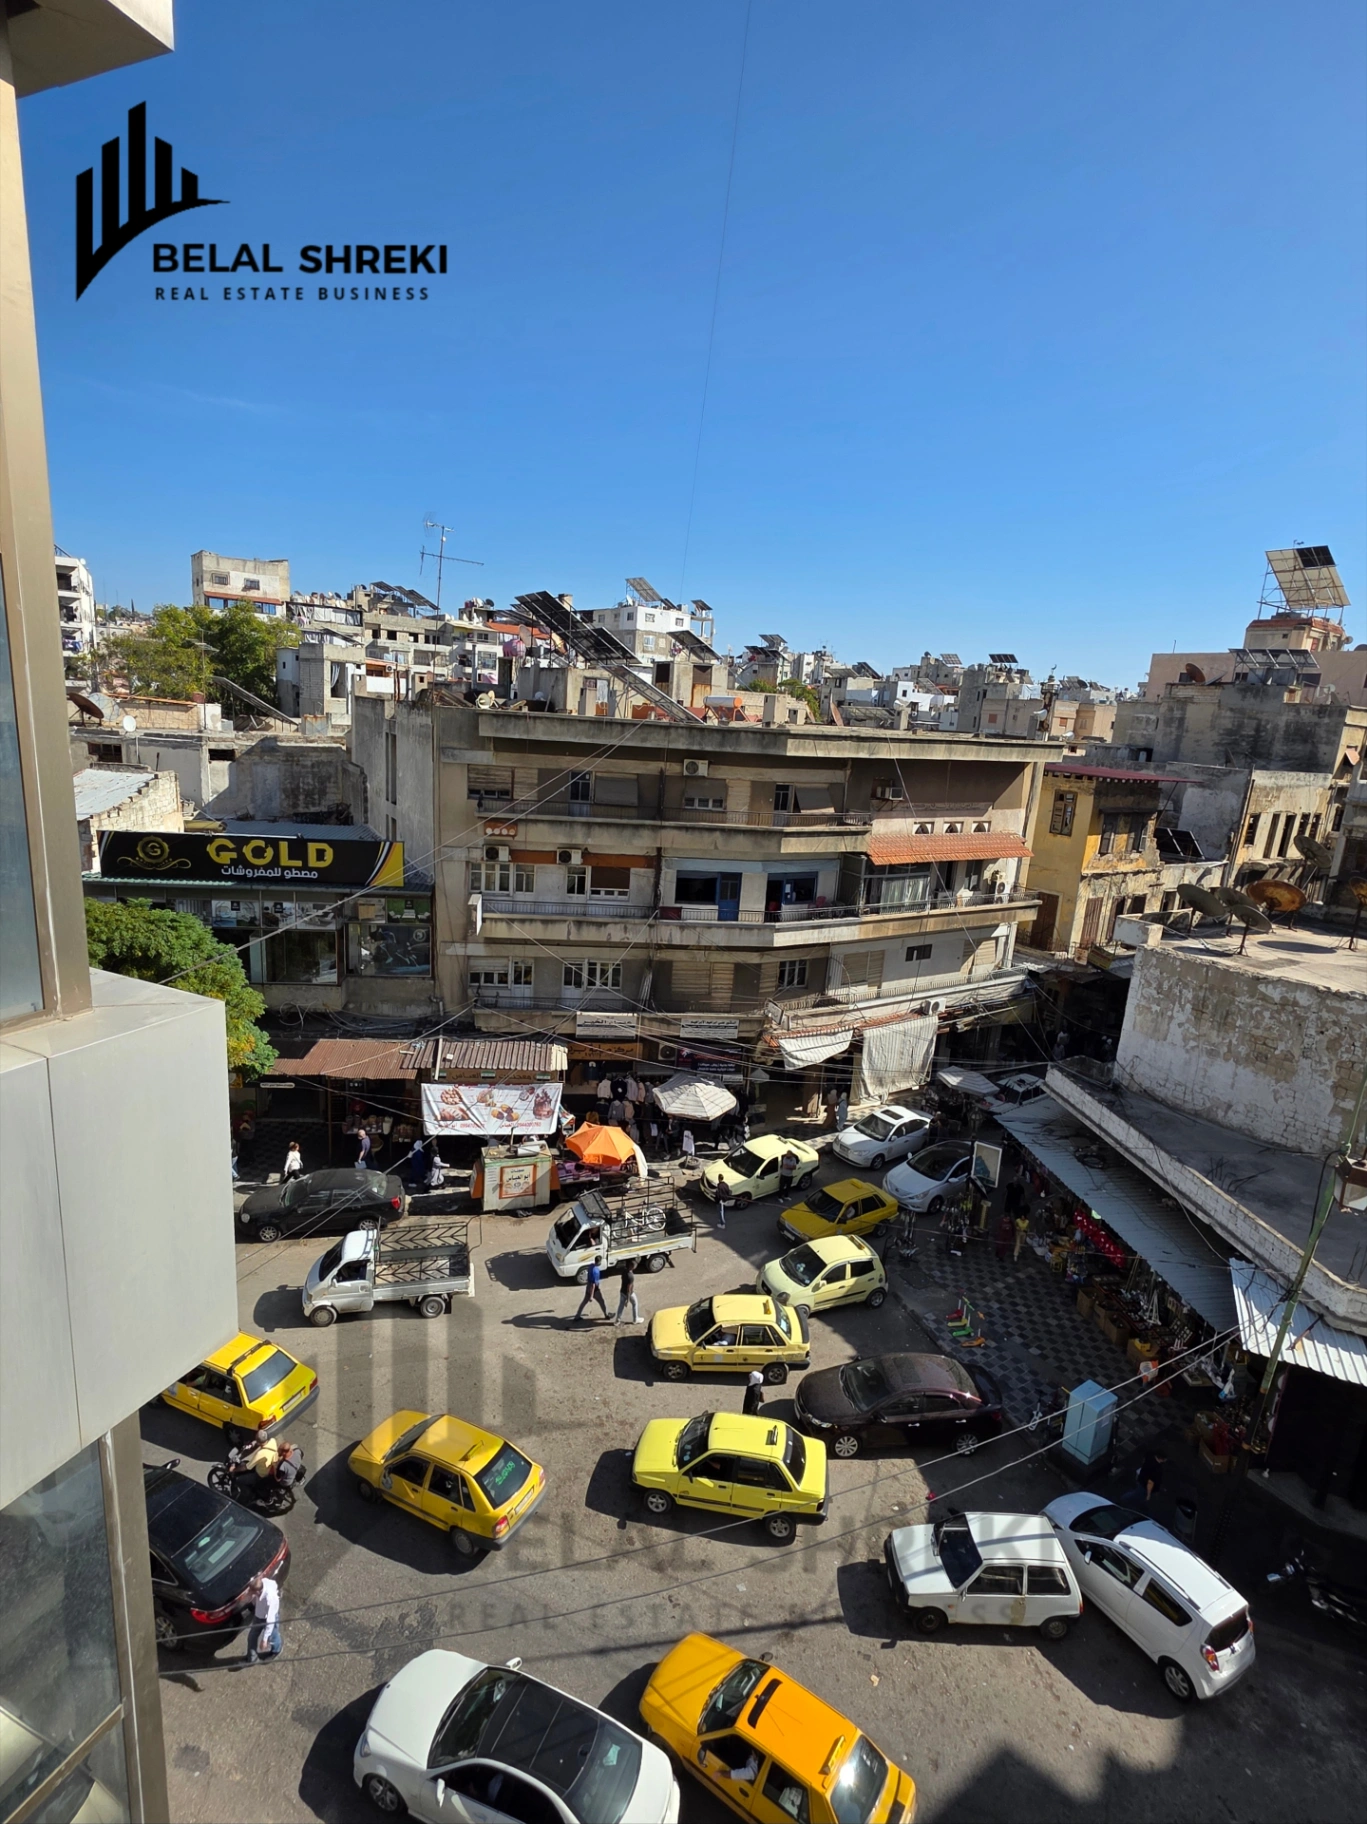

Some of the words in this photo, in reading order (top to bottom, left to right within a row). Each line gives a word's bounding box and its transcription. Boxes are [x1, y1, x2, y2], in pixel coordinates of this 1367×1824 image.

[206, 838, 334, 868] GOLD
[221, 865, 281, 878] للمفروشات
[284, 868, 318, 879] مصطو
